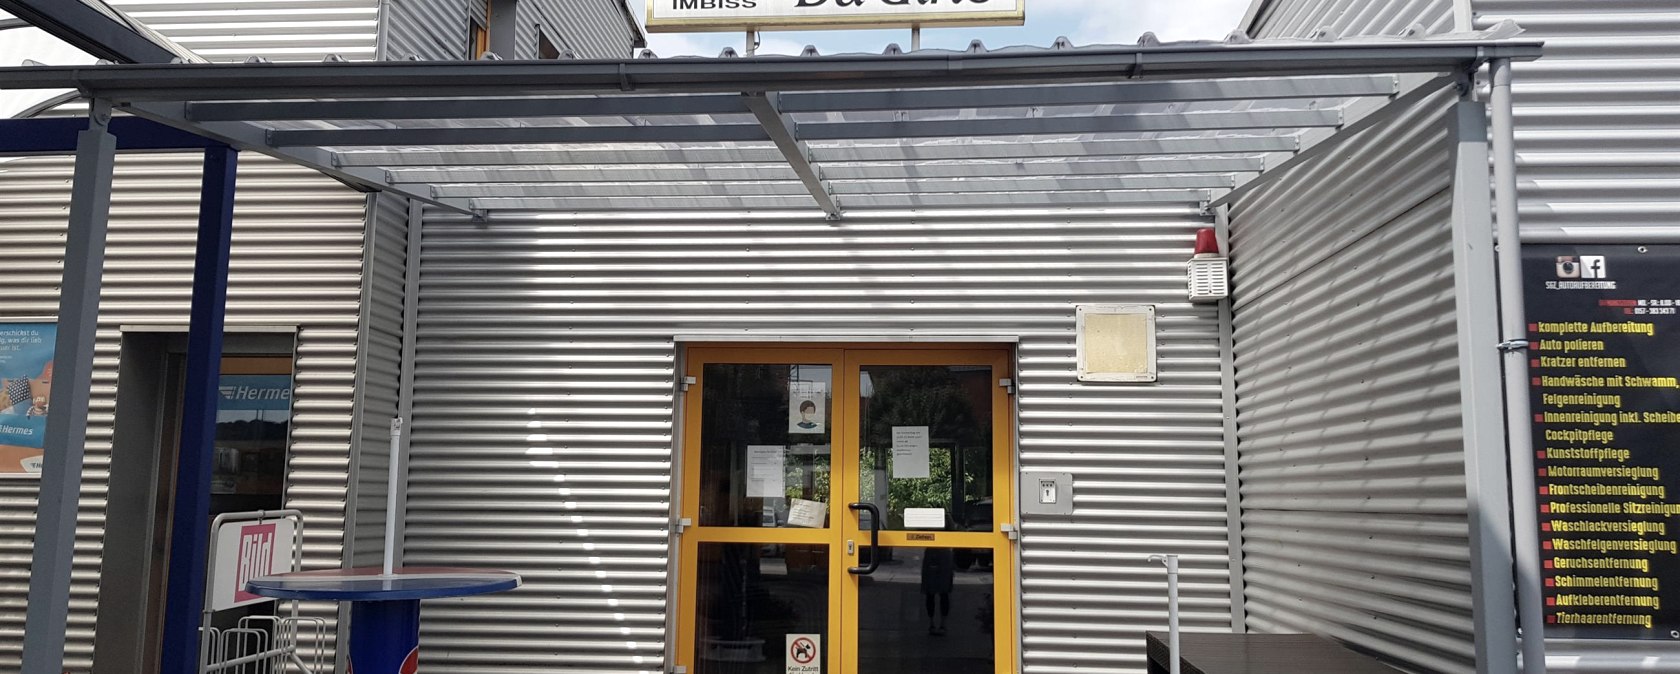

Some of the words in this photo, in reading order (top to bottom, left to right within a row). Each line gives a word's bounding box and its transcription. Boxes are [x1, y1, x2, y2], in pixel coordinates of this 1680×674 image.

[672, 0, 757, 10] IMBISS
[1590, 321, 1654, 336] Aufbereitung
[1539, 339, 1562, 351] Auto
[1564, 339, 1604, 353] polieren
[1541, 356, 1576, 368] Kratzer
[1578, 356, 1627, 368] entfernen
[1542, 375, 1605, 387] Handwäsche
[1606, 375, 1623, 387] mit
[1624, 376, 1680, 389] Schwamm,
[1543, 393, 1621, 408] Felgenreinigung
[1544, 411, 1618, 426] Innenreinigung
[1619, 411, 1641, 423] inkl.
[2, 425, 33, 436] Hermes
[1545, 429, 1614, 445] Cockpitpflege
[1546, 447, 1630, 462] Kunststoffpflege
[1548, 466, 1659, 481] Motorraumversieglung
[1549, 484, 1665, 499] Frontscheibenreinigung
[1550, 502, 1621, 514] Professionelle
[1551, 520, 1665, 535] Waschlackversieglung
[1552, 538, 1677, 554] Waschfelgenversieglung
[238, 532, 273, 592] Bild
[1554, 557, 1649, 572] Geruchsentfernung
[1555, 575, 1659, 591] Schimmelentfernung
[1556, 594, 1659, 609] Aufkleberentfernung
[1556, 612, 1652, 628] Tierhaarentfernung
